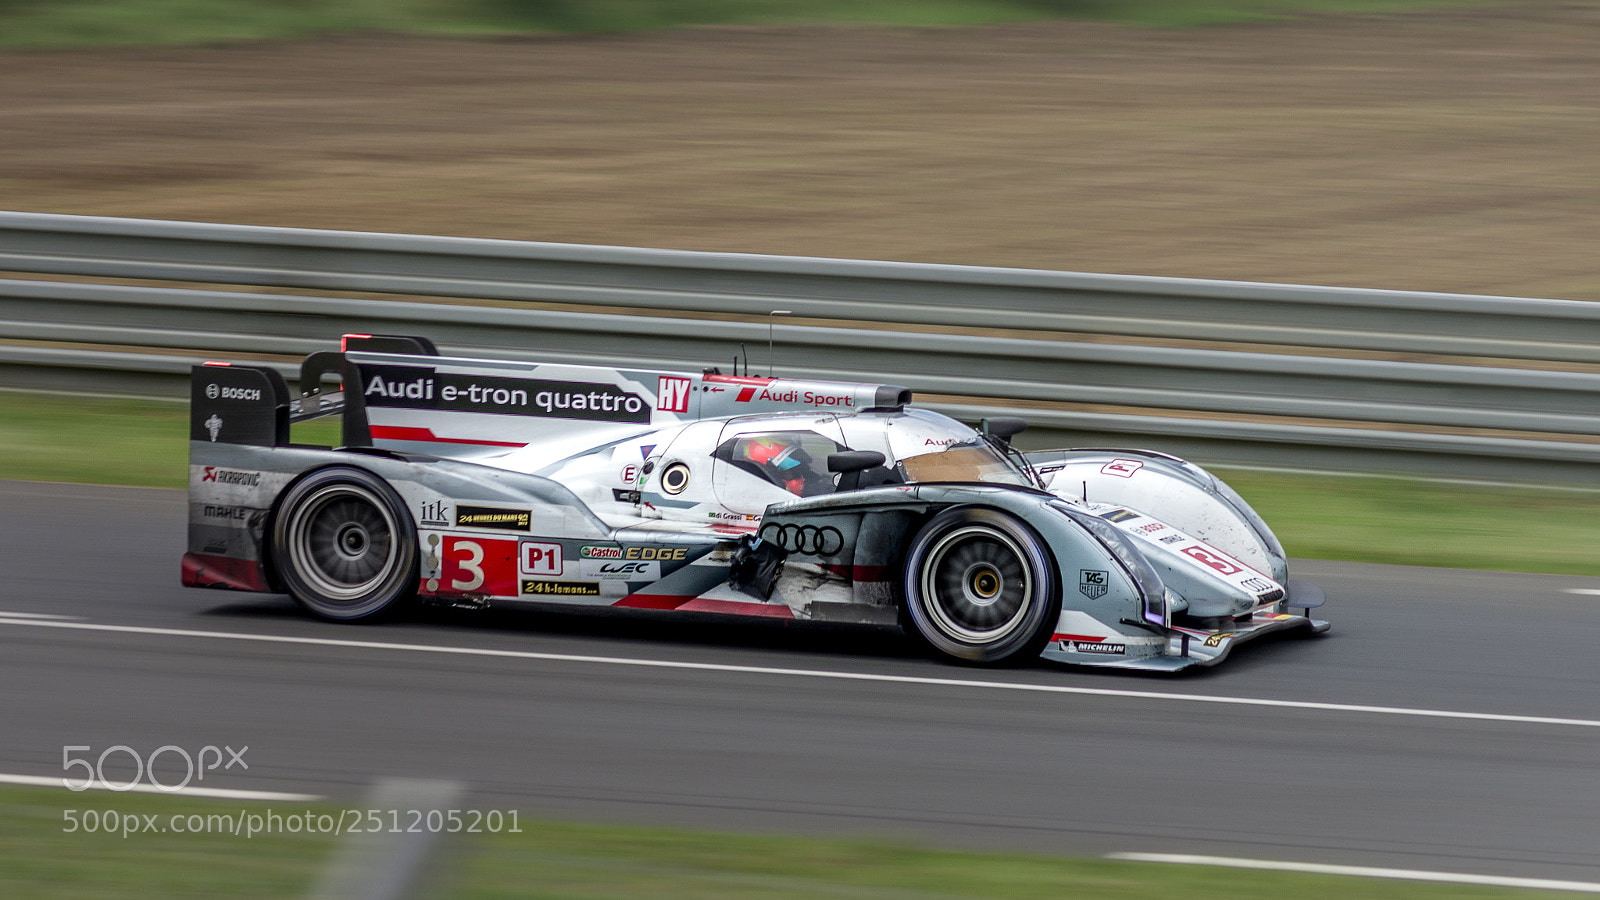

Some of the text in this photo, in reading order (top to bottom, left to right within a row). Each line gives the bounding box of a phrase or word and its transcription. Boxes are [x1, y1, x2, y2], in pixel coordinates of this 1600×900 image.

[221, 387, 261, 400] BOSCH
[365, 375, 642, 413] Audi e-tron quattro
[657, 378, 690, 411] HY
[759, 389, 852, 408] Audi Sport
[624, 467, 635, 481] E
[204, 505, 245, 519] MAHLE
[421, 500, 449, 521] itk
[723, 512, 742, 520] Grassi
[458, 514, 473, 523] 24
[528, 547, 554, 570] P1
[591, 547, 689, 560] Castrol EDGE
[1187, 548, 1235, 573] 3
[452, 541, 485, 592] 3
[600, 563, 649, 573] WEC
[1085, 572, 1104, 584] TAG
[1081, 585, 1106, 597] HEUER
[1078, 643, 1124, 652] MICHELIN
